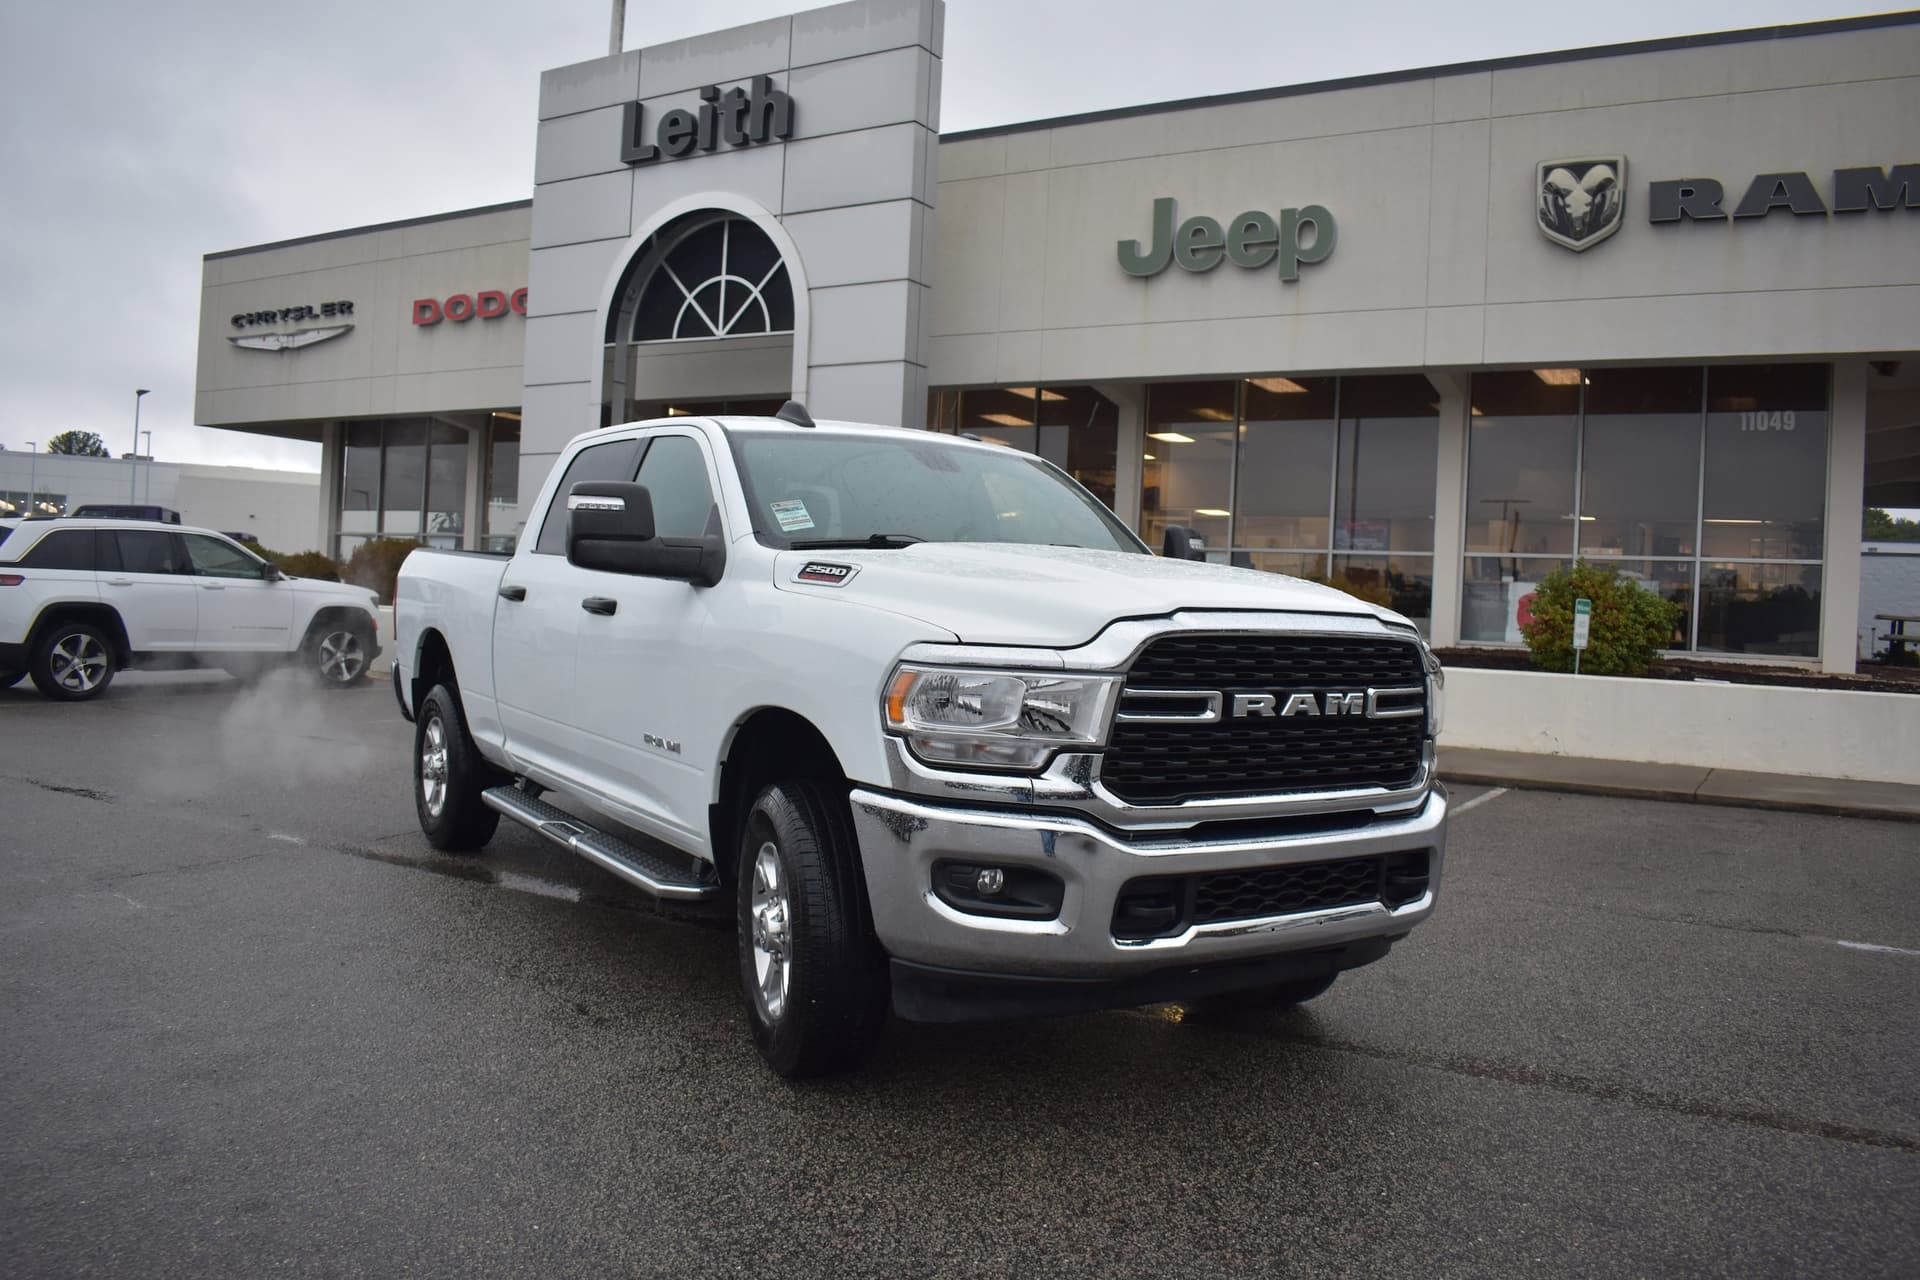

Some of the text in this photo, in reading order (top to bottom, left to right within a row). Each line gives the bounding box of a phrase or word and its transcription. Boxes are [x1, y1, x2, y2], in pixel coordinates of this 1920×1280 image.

[620, 75, 796, 166] Leith
[1649, 163, 1920, 225] RAM
[1117, 197, 1338, 283] Jeep
[231, 300, 354, 329] CHRYSLER
[1741, 410, 1796, 431] 11049
[805, 564, 848, 577] 2500
[1232, 693, 1364, 718] RAM
